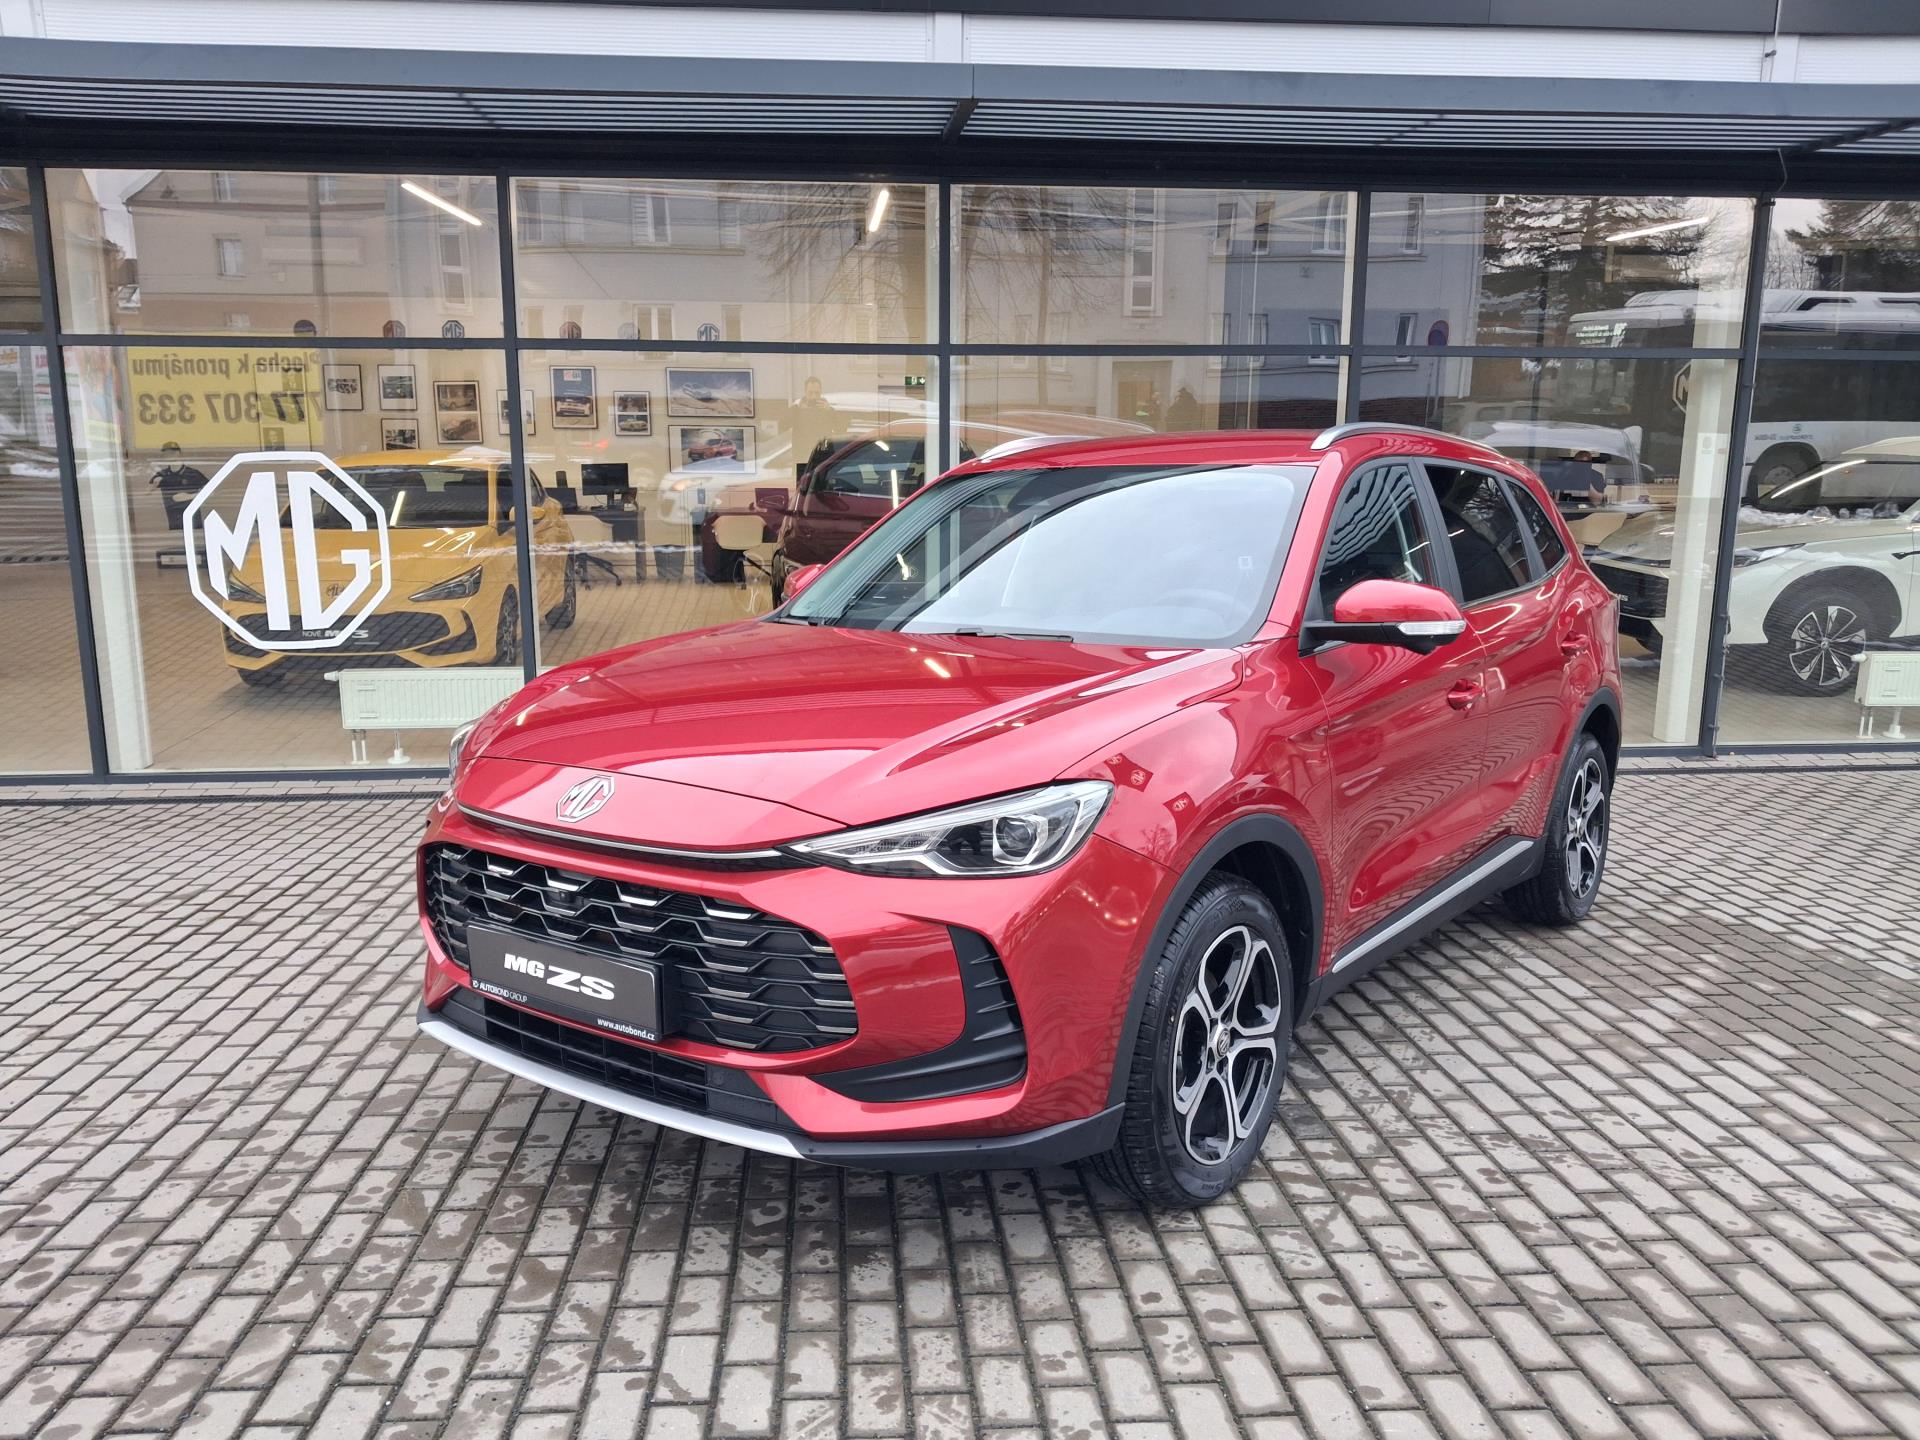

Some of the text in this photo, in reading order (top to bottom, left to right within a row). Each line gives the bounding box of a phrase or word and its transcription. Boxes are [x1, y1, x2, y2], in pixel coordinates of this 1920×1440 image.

[444, 323, 463, 338] MG
[699, 325, 718, 341] MG
[203, 471, 371, 631] MG
[560, 777, 611, 819] MG
[504, 953, 615, 1001] MG ZS
[479, 983, 510, 998] AUTOBOND
[597, 1018, 656, 1041] www.autobond.cz
